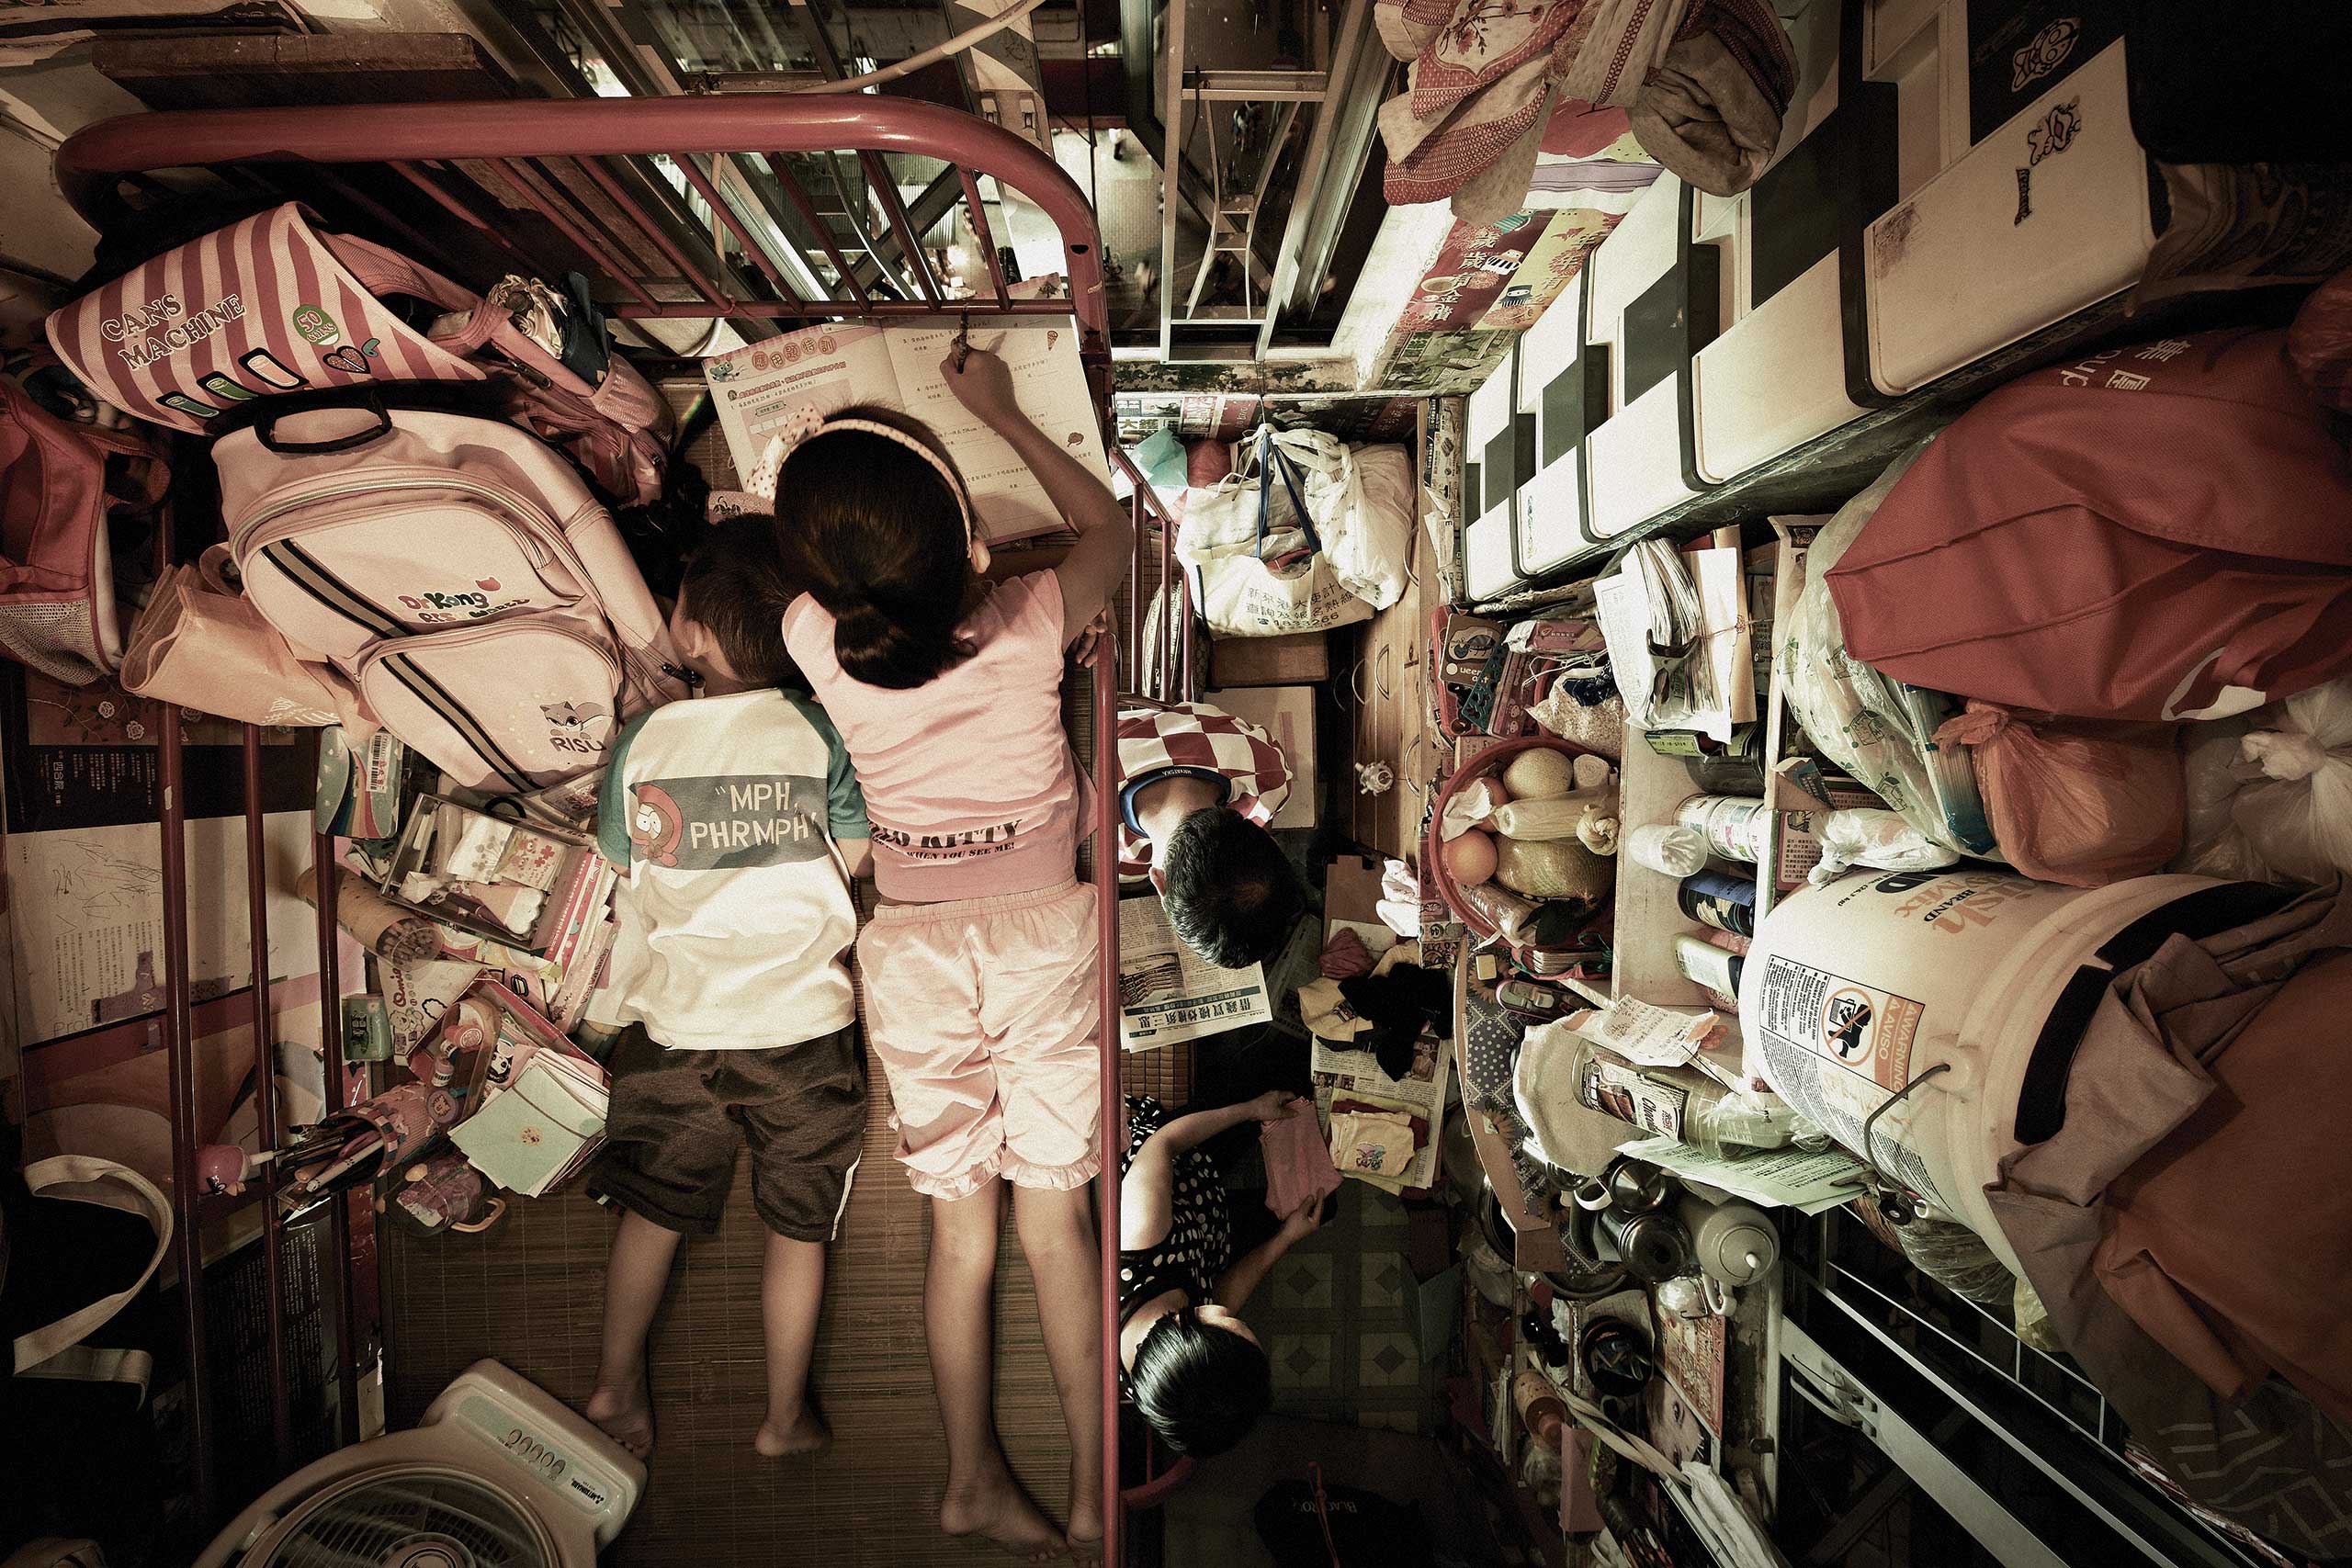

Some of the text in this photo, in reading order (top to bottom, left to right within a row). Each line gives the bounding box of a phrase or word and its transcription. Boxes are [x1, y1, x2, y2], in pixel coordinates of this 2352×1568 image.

[100, 294, 182, 343] CANS
[119, 294, 246, 370] MACHINE
[296, 310, 323, 333] 50
[306, 322, 338, 344] COINS
[549, 736, 606, 753] RISU
[943, 850, 967, 859] YOU
[968, 847, 992, 857] SEE
[994, 842, 1015, 853] ME!
[1924, 889, 1977, 922] BRAND
[1138, 998, 1250, 1028] 借錢買樓炒樓須三思
[1879, 1011, 1895, 1060] AVISO
[1893, 1010, 1920, 1092] WARNING
